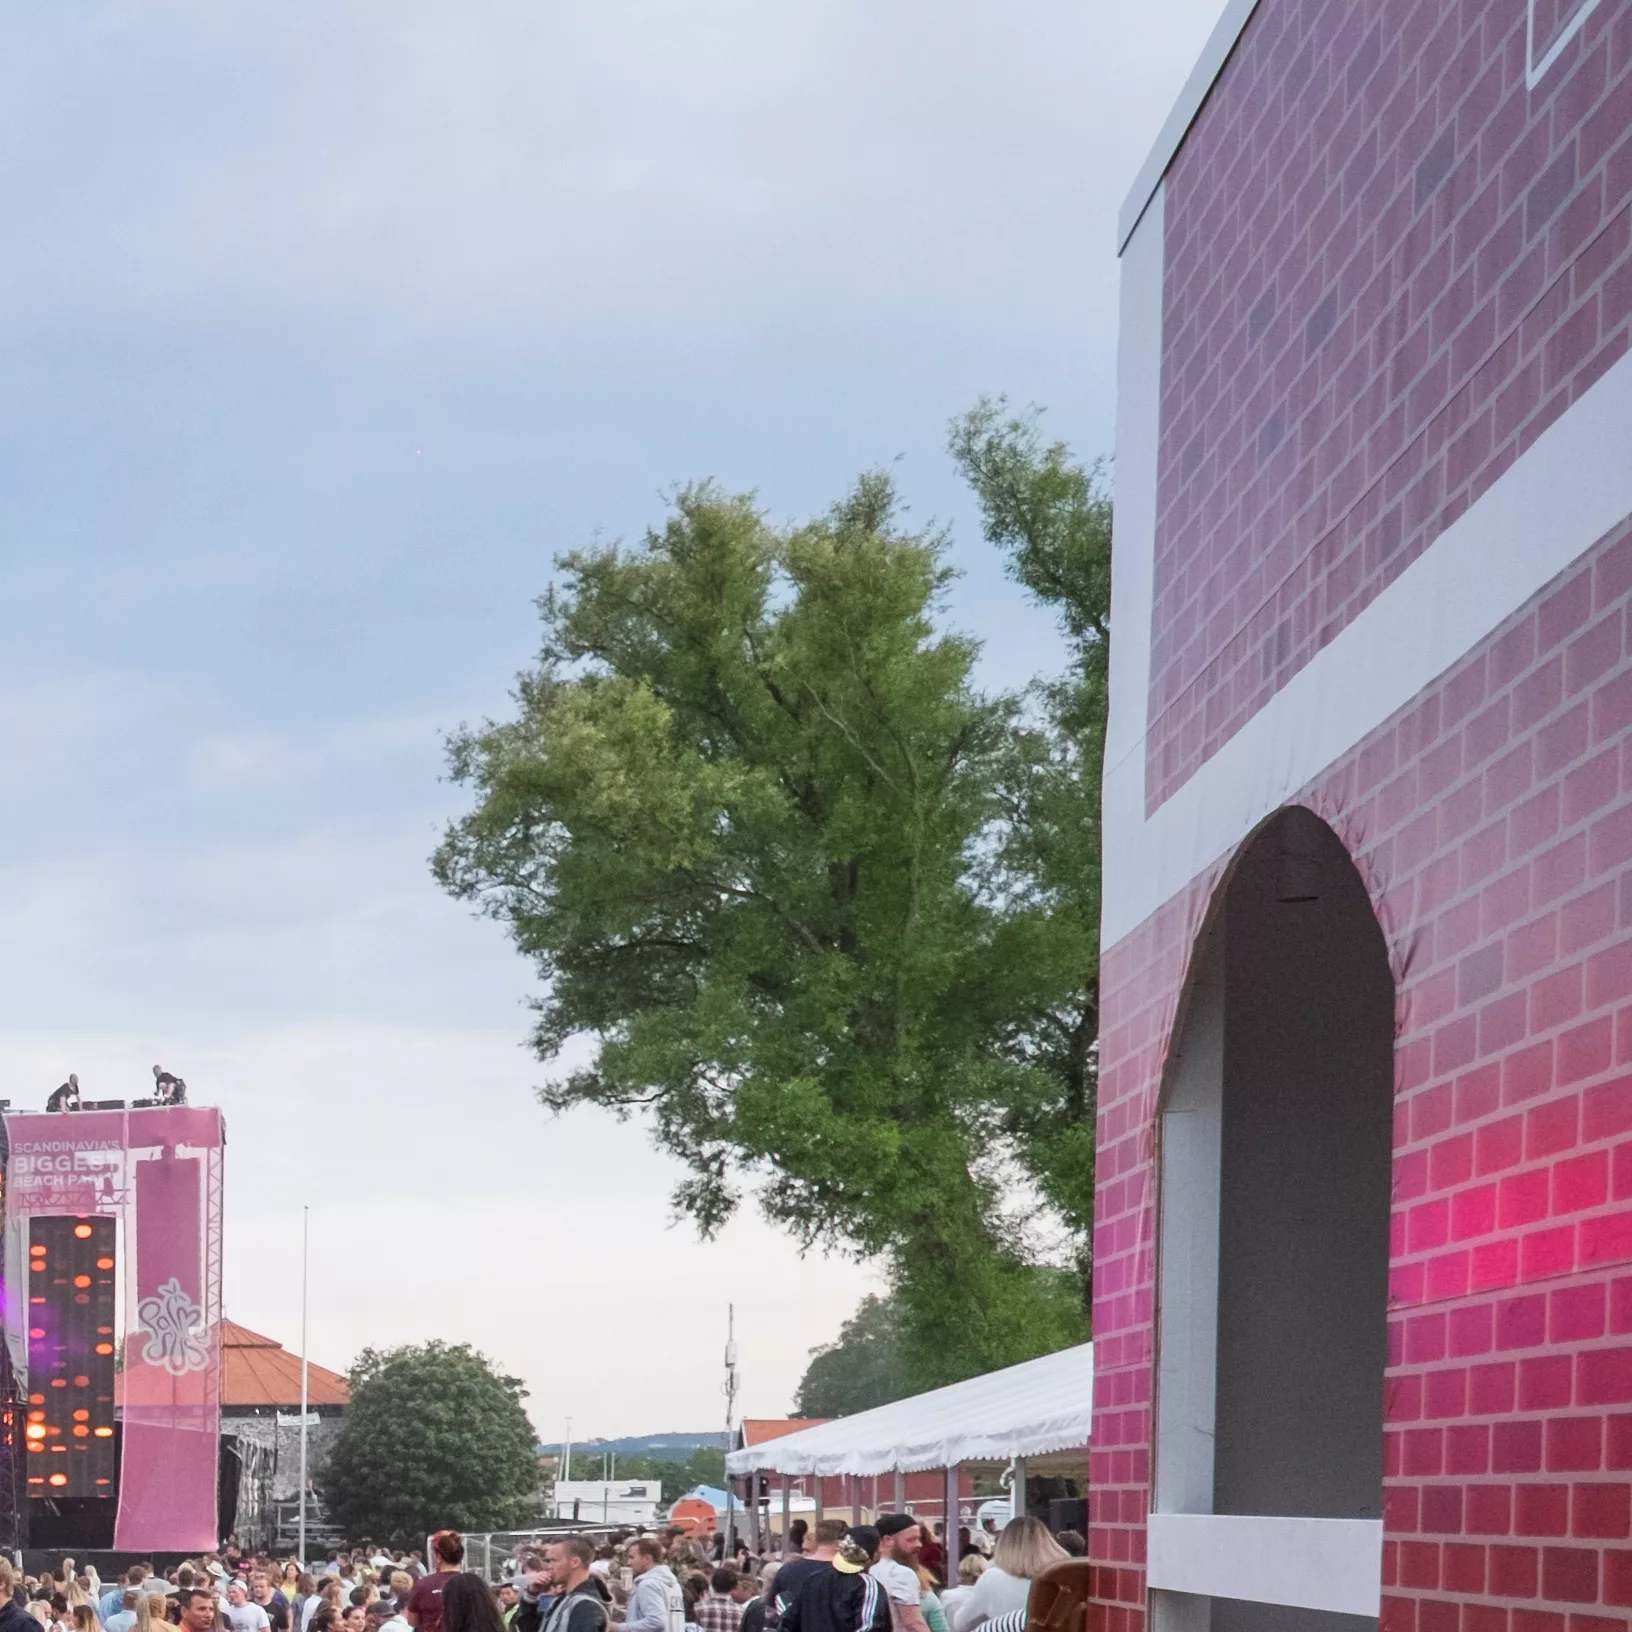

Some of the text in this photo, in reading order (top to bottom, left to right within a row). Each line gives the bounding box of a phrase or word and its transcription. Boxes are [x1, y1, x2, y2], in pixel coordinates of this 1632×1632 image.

[14, 1140, 121, 1153] SCANDINAVIA'S
[14, 1154, 117, 1174] BIGGEST
[13, 1175, 64, 1188] BEACH
